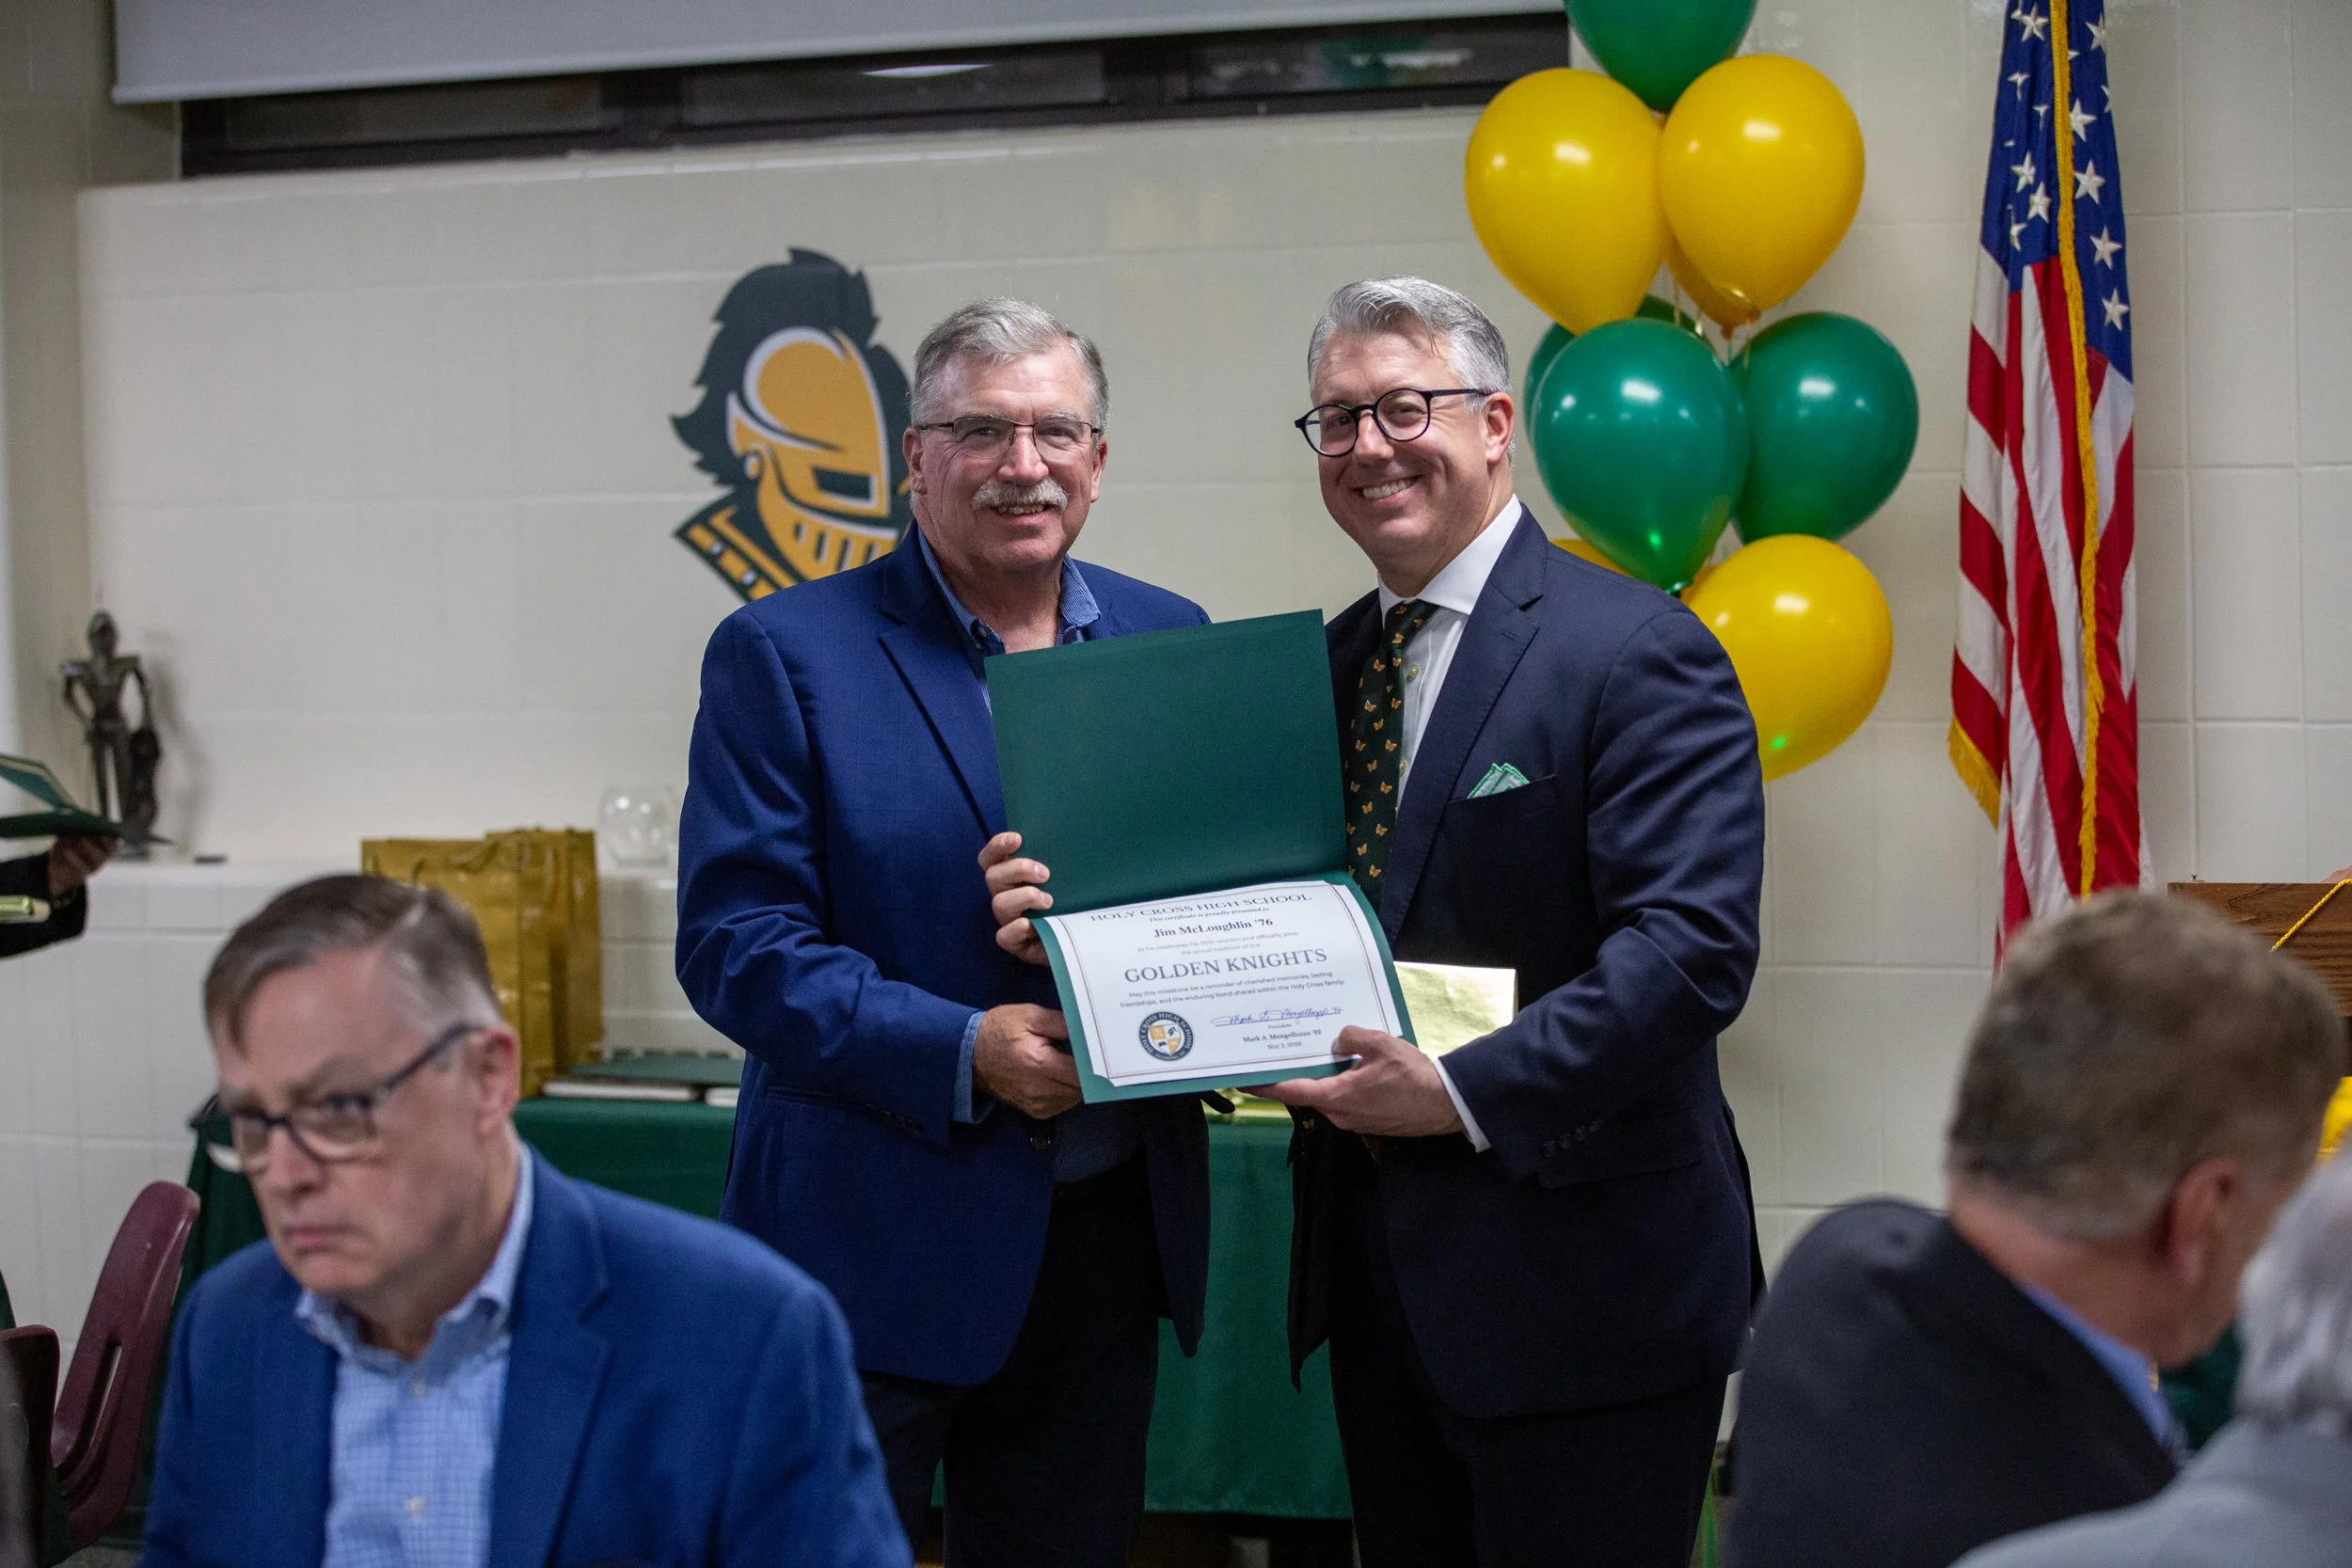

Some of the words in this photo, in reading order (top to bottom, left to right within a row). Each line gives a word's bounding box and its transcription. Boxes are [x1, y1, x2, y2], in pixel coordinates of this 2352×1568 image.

[1090, 911, 1136, 922] HOLY
[1140, 905, 1193, 916] CROSS
[1197, 900, 1239, 911] HIGH
[1243, 894, 1312, 906] SCHOOL
[1153, 928, 1176, 938] Jim
[1179, 921, 1252, 934] McLoughlin
[1254, 918, 1274, 927] '76
[1124, 959, 1220, 983] GOLDEN
[1226, 948, 1327, 973] KNIGHTS
[1205, 981, 1234, 990] reminder
[1244, 977, 1276, 986] cherished
[1234, 988, 1256, 996] shared
